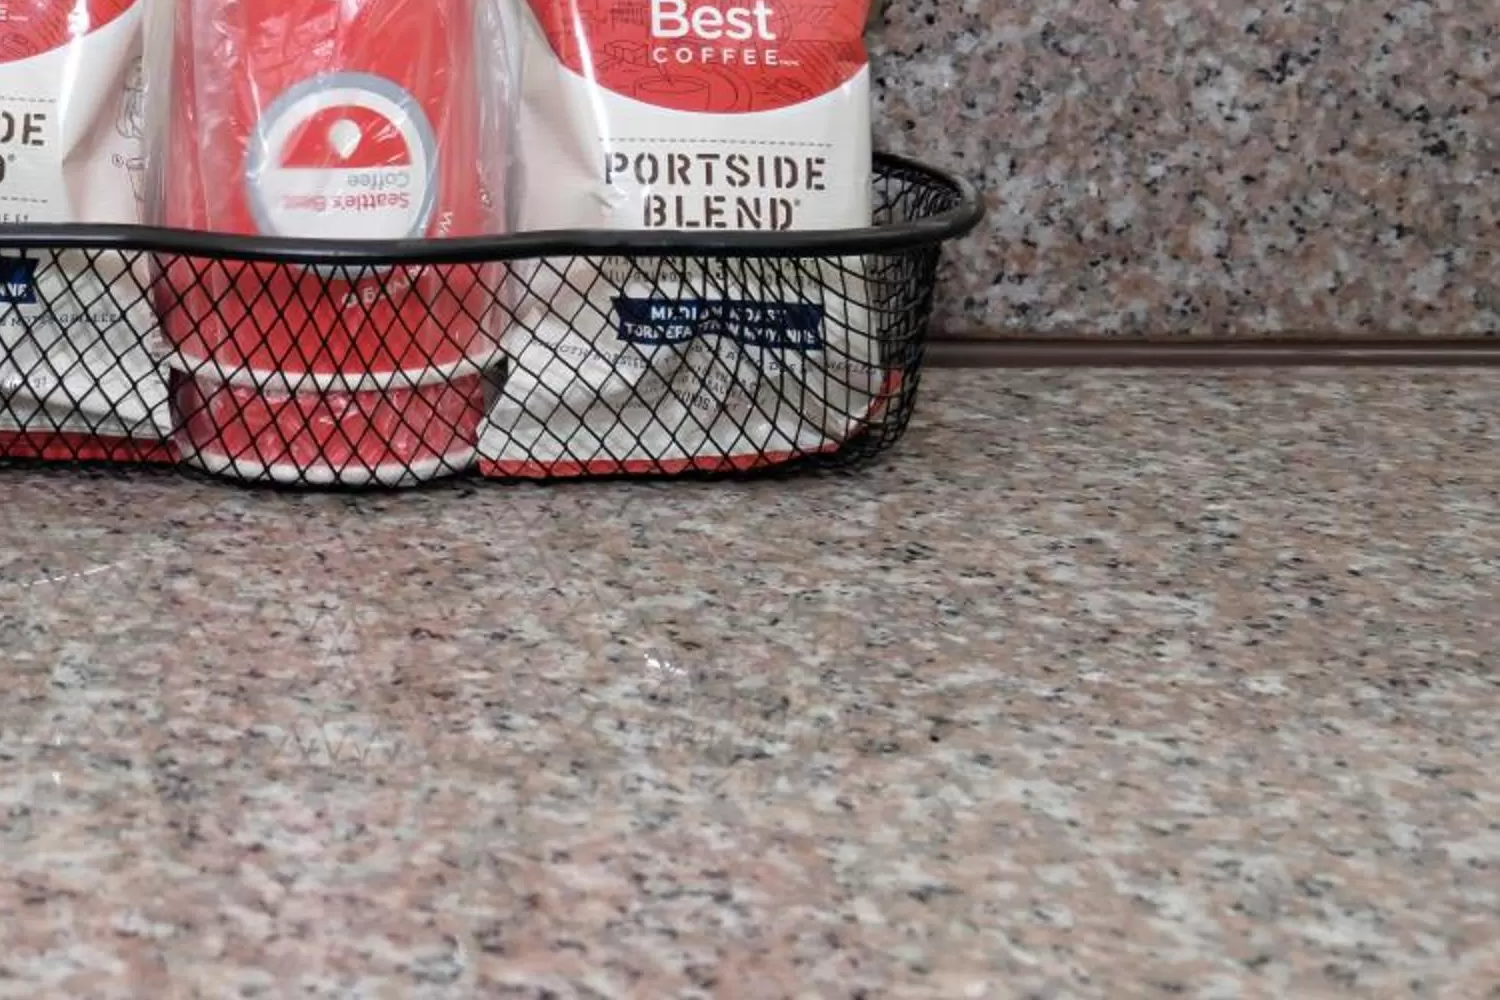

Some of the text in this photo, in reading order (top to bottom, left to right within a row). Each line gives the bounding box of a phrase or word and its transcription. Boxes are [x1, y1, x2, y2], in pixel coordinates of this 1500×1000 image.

[652, 47, 779, 66] COFFEE
[347, 171, 410, 189] Coffee
[605, 152, 826, 190] PORTSIDE
[332, 191, 410, 212] Seattle's
[643, 195, 794, 231] BLEND
